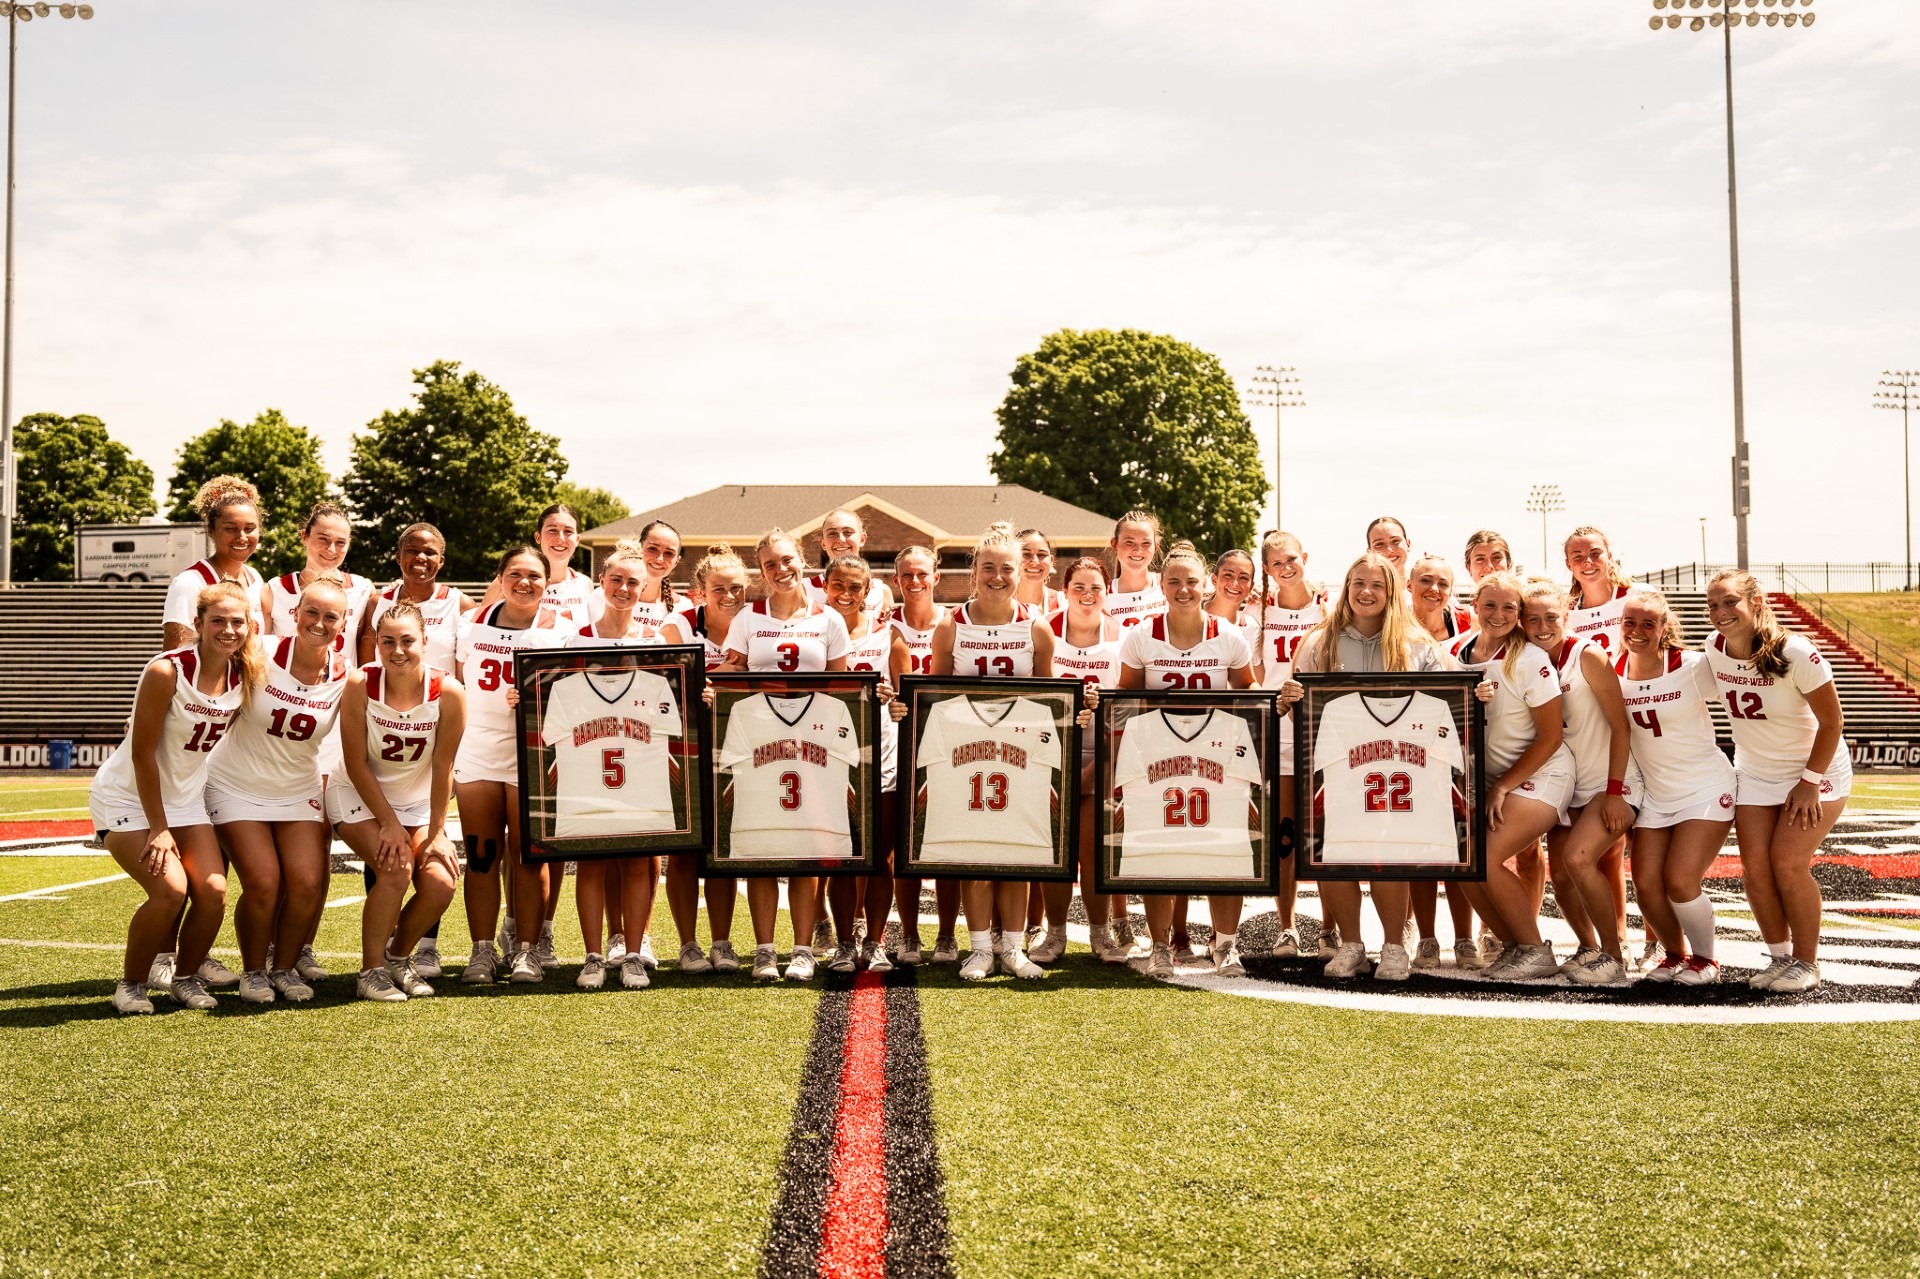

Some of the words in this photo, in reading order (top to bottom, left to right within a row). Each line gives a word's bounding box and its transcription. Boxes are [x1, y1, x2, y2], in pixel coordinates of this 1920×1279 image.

[128, 561, 150, 569] POLICE
[131, 552, 167, 560] UNIVERSITY
[1110, 600, 1167, 616] GARDNER-WEBB
[1265, 622, 1319, 632] GARDNER-WE
[474, 642, 534, 655] GARDNER-
[777, 642, 800, 672] 3
[960, 640, 1026, 651] GARDNER-WEBB
[974, 655, 1015, 677] 13
[1053, 655, 1110, 670] GARDNER-WEBB
[1153, 658, 1219, 668] GARDNER-WEBB
[1716, 671, 1775, 687] GARDNER-WEBB
[1726, 689, 1768, 721] 12
[183, 721, 227, 753] 15
[266, 707, 318, 742] 19
[572, 716, 652, 748] GARDNER-WEBB
[1632, 709, 1663, 738] 4
[381, 733, 428, 763] 27
[753, 738, 828, 769] GARDNER-WEBB
[952, 739, 1028, 770] GARDNER-WEBB
[1348, 739, 1427, 770] GARDNER-WEBB
[601, 748, 626, 790] 5
[1147, 755, 1224, 785] GARDNER-WEBB
[779, 771, 802, 811] 3
[968, 771, 1009, 812] 13
[1364, 771, 1413, 812] 22
[1163, 786, 1210, 828] 20
